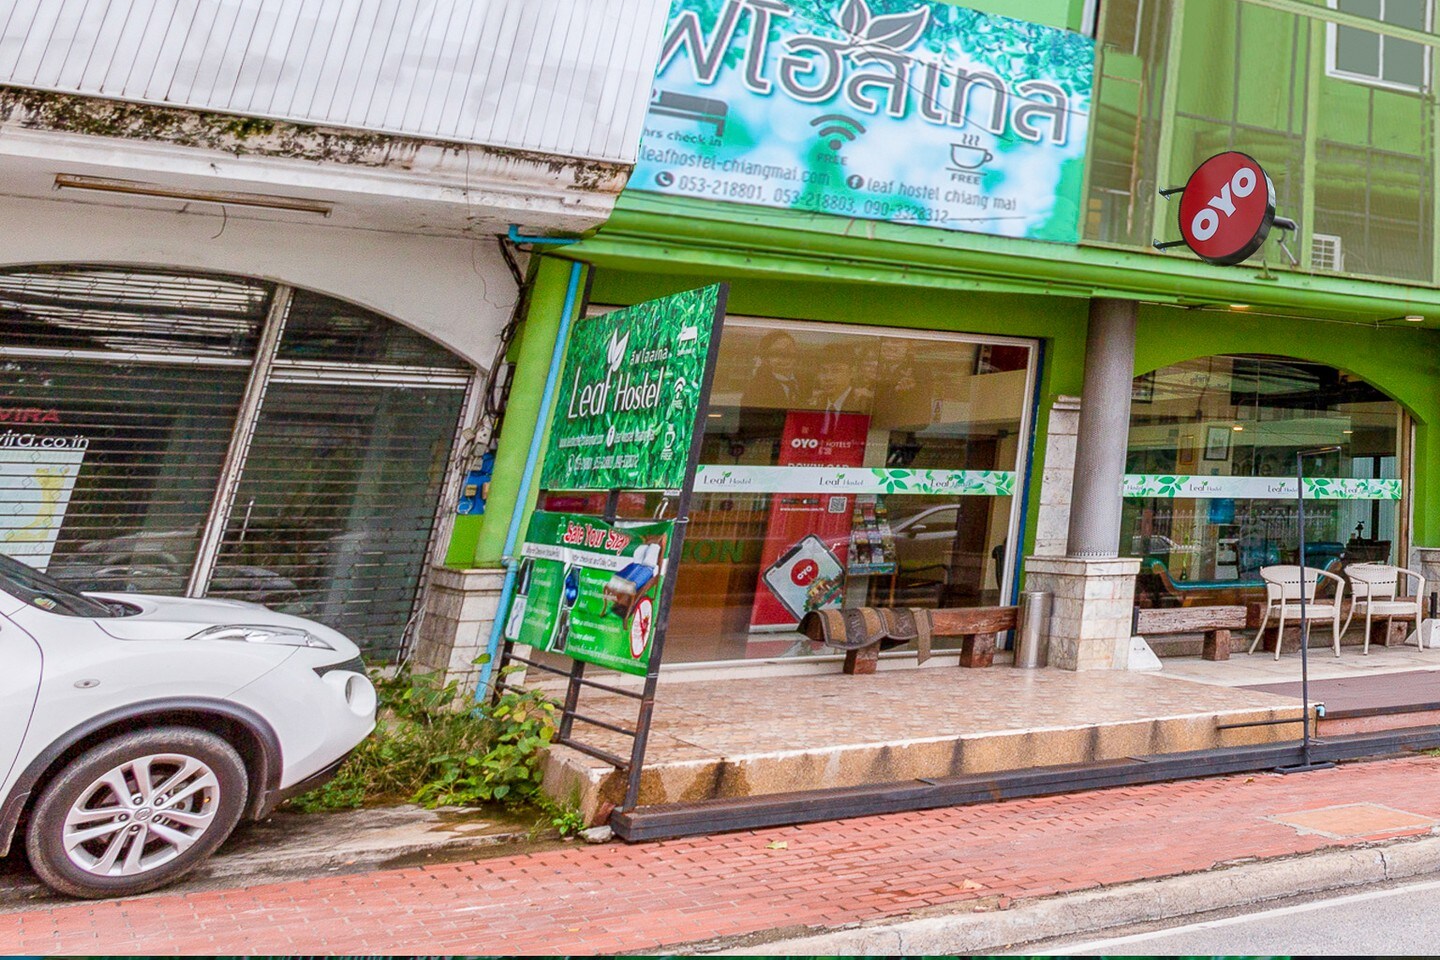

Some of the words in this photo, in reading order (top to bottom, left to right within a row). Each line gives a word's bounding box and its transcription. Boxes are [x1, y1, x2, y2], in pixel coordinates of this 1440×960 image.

[667, 130, 705, 145] check
[708, 137, 722, 147] in
[816, 152, 848, 166] FREE
[951, 171, 981, 185] FREE
[867, 177, 894, 194] leaf
[899, 182, 940, 201] hostel
[944, 187, 989, 211] chiang
[992, 196, 1017, 211] mai
[1191, 167, 1257, 241] OYO
[567, 366, 612, 419] Leaf
[613, 366, 665, 412] Hostel
[791, 438, 819, 449] OYO
[703, 474, 727, 485] Leaf
[819, 476, 841, 486] Leaf
[1189, 483, 1206, 492] Leaf
[585, 523, 606, 547] Your
[605, 528, 631, 556] Stay
[796, 564, 813, 581] OYO
